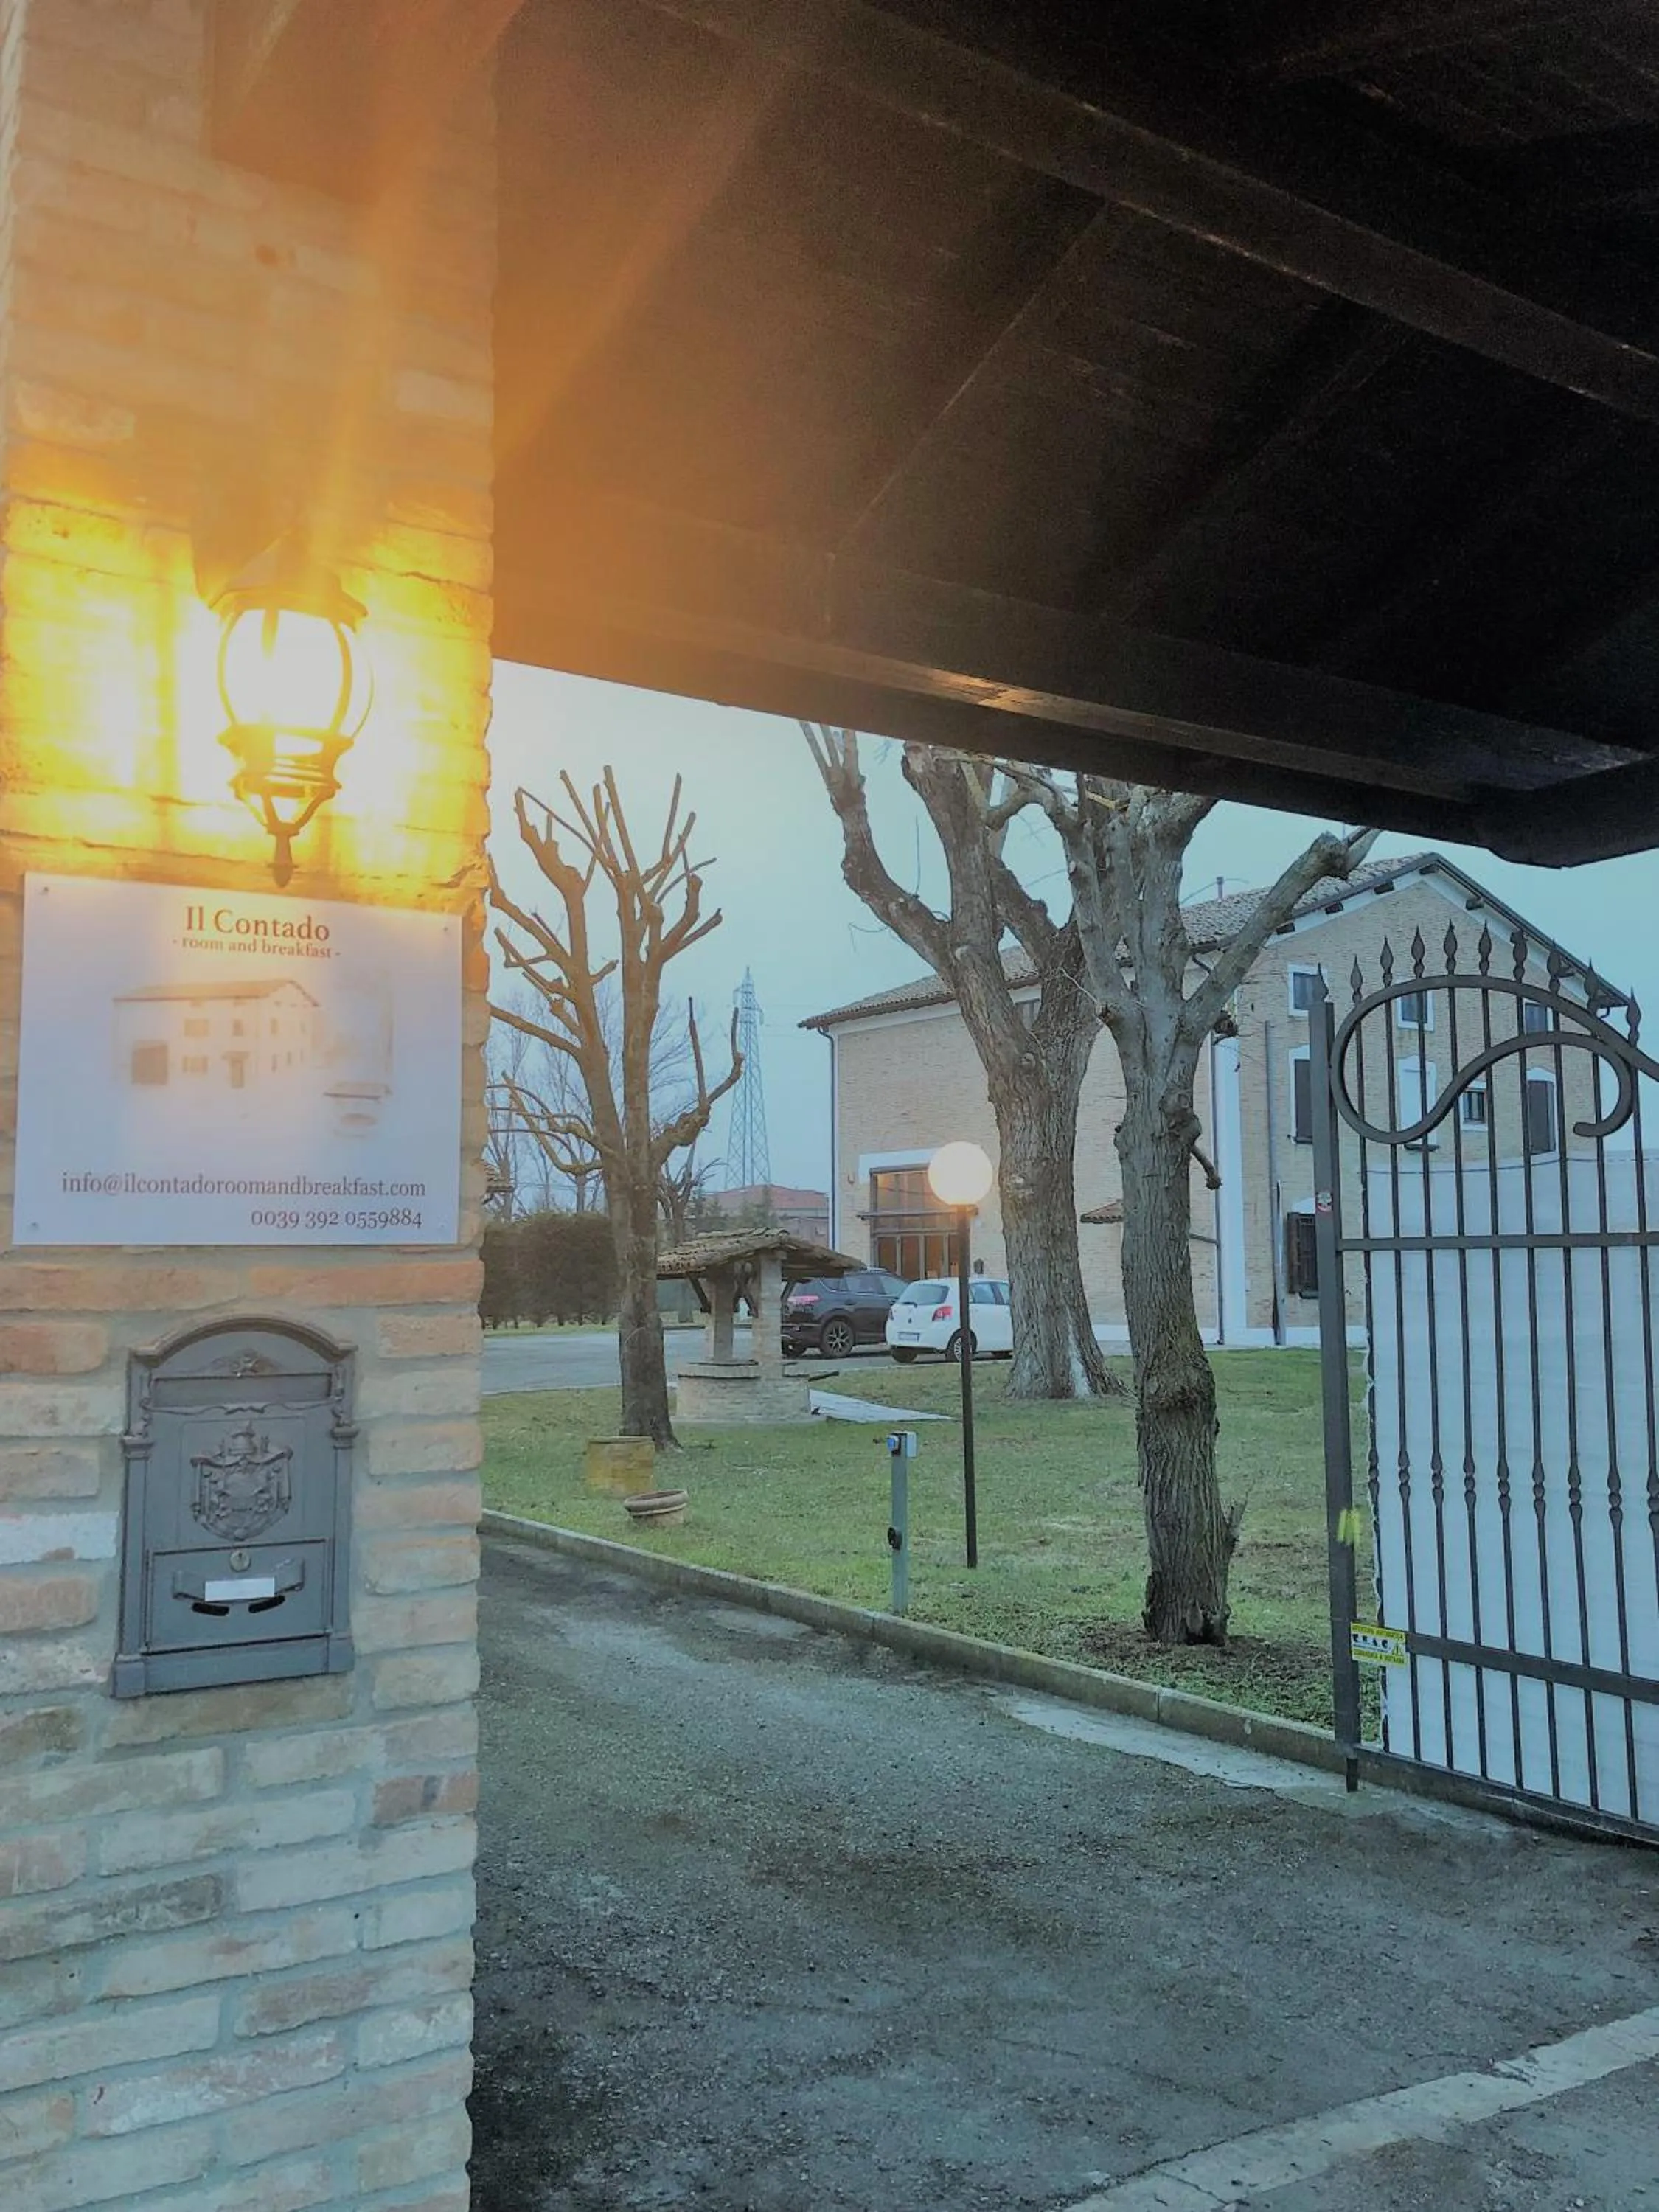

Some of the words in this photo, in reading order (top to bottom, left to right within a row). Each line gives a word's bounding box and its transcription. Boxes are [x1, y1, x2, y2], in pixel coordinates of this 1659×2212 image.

[186, 905, 204, 931] Il
[213, 908, 330, 941] Contado
[182, 937, 223, 950] room
[229, 938, 257, 953] and
[262, 939, 332, 958] breakfast
[62, 1172, 425, 1197] info@ilcontadoroomandbreakfast.com
[251, 1210, 300, 1229] 0039
[305, 1210, 339, 1229] 392
[344, 1207, 422, 1229] 0559884
